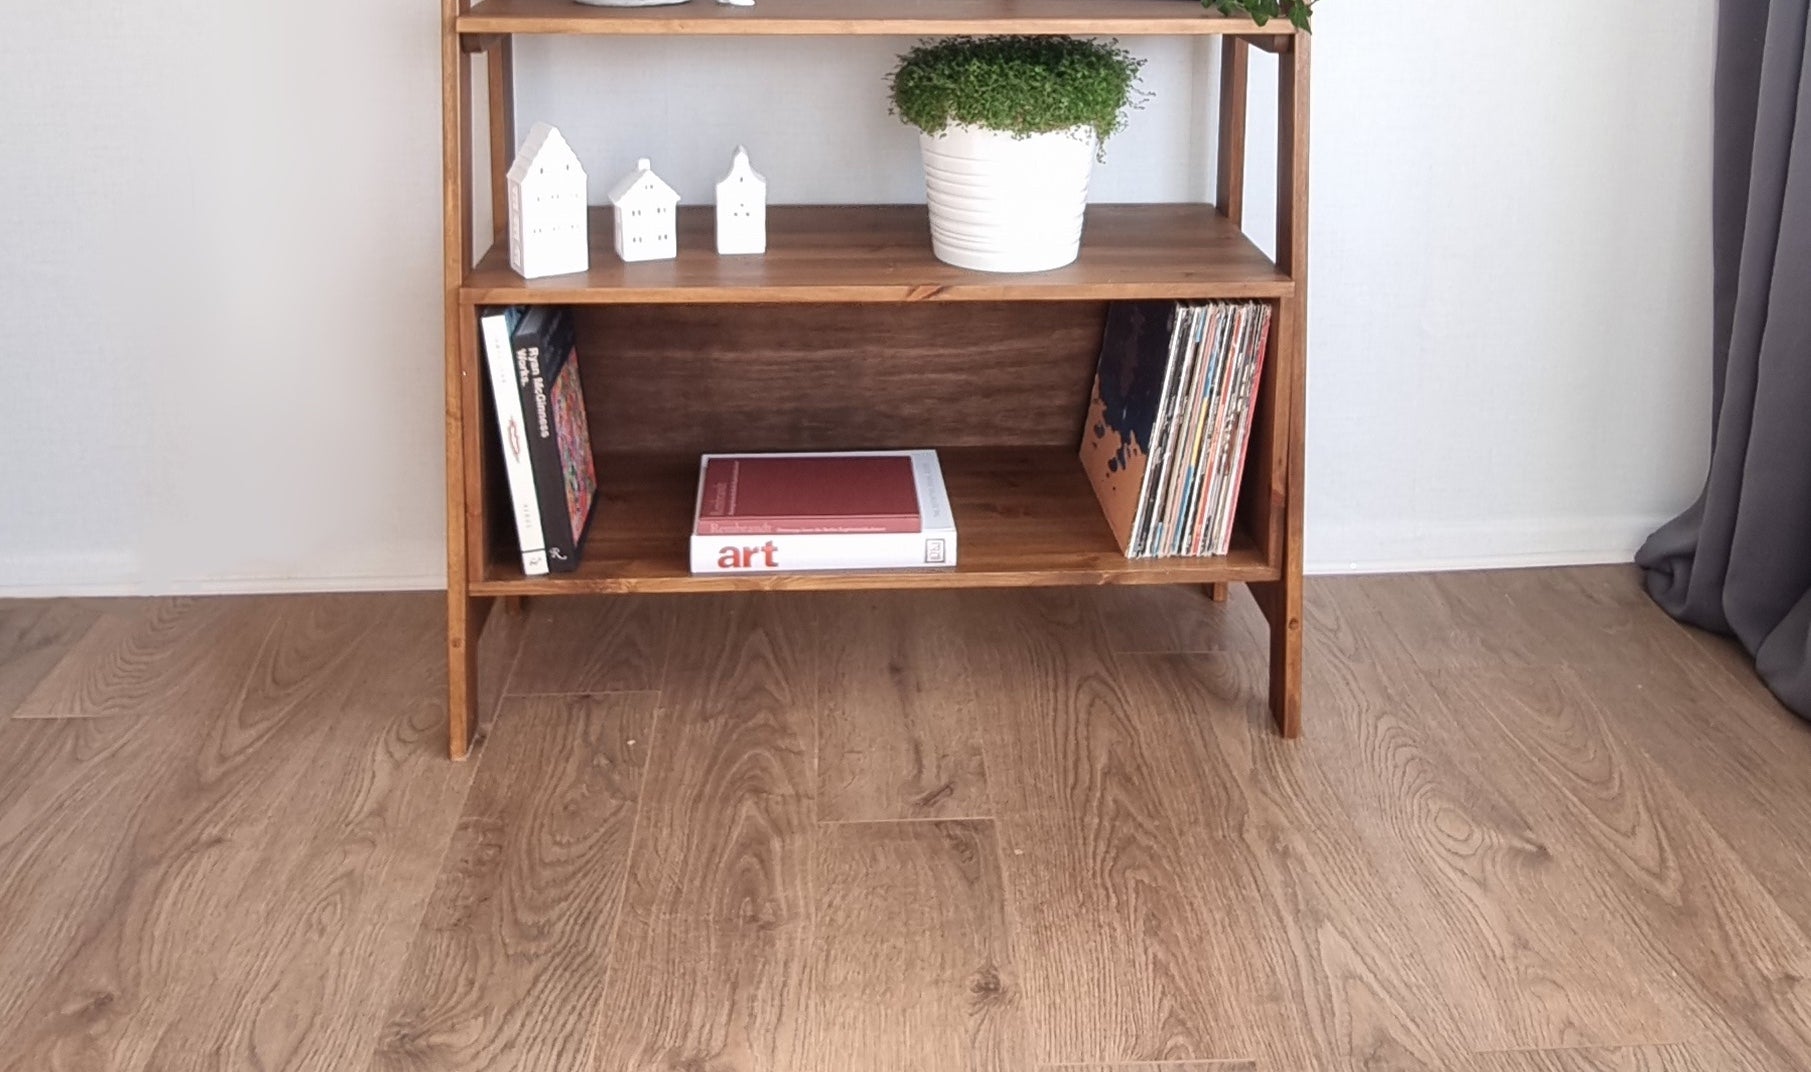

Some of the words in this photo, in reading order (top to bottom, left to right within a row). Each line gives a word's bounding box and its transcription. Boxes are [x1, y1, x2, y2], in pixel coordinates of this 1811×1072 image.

[528, 346, 540, 375] Ryan
[533, 376, 550, 438] McGinness
[717, 540, 779, 568] art
